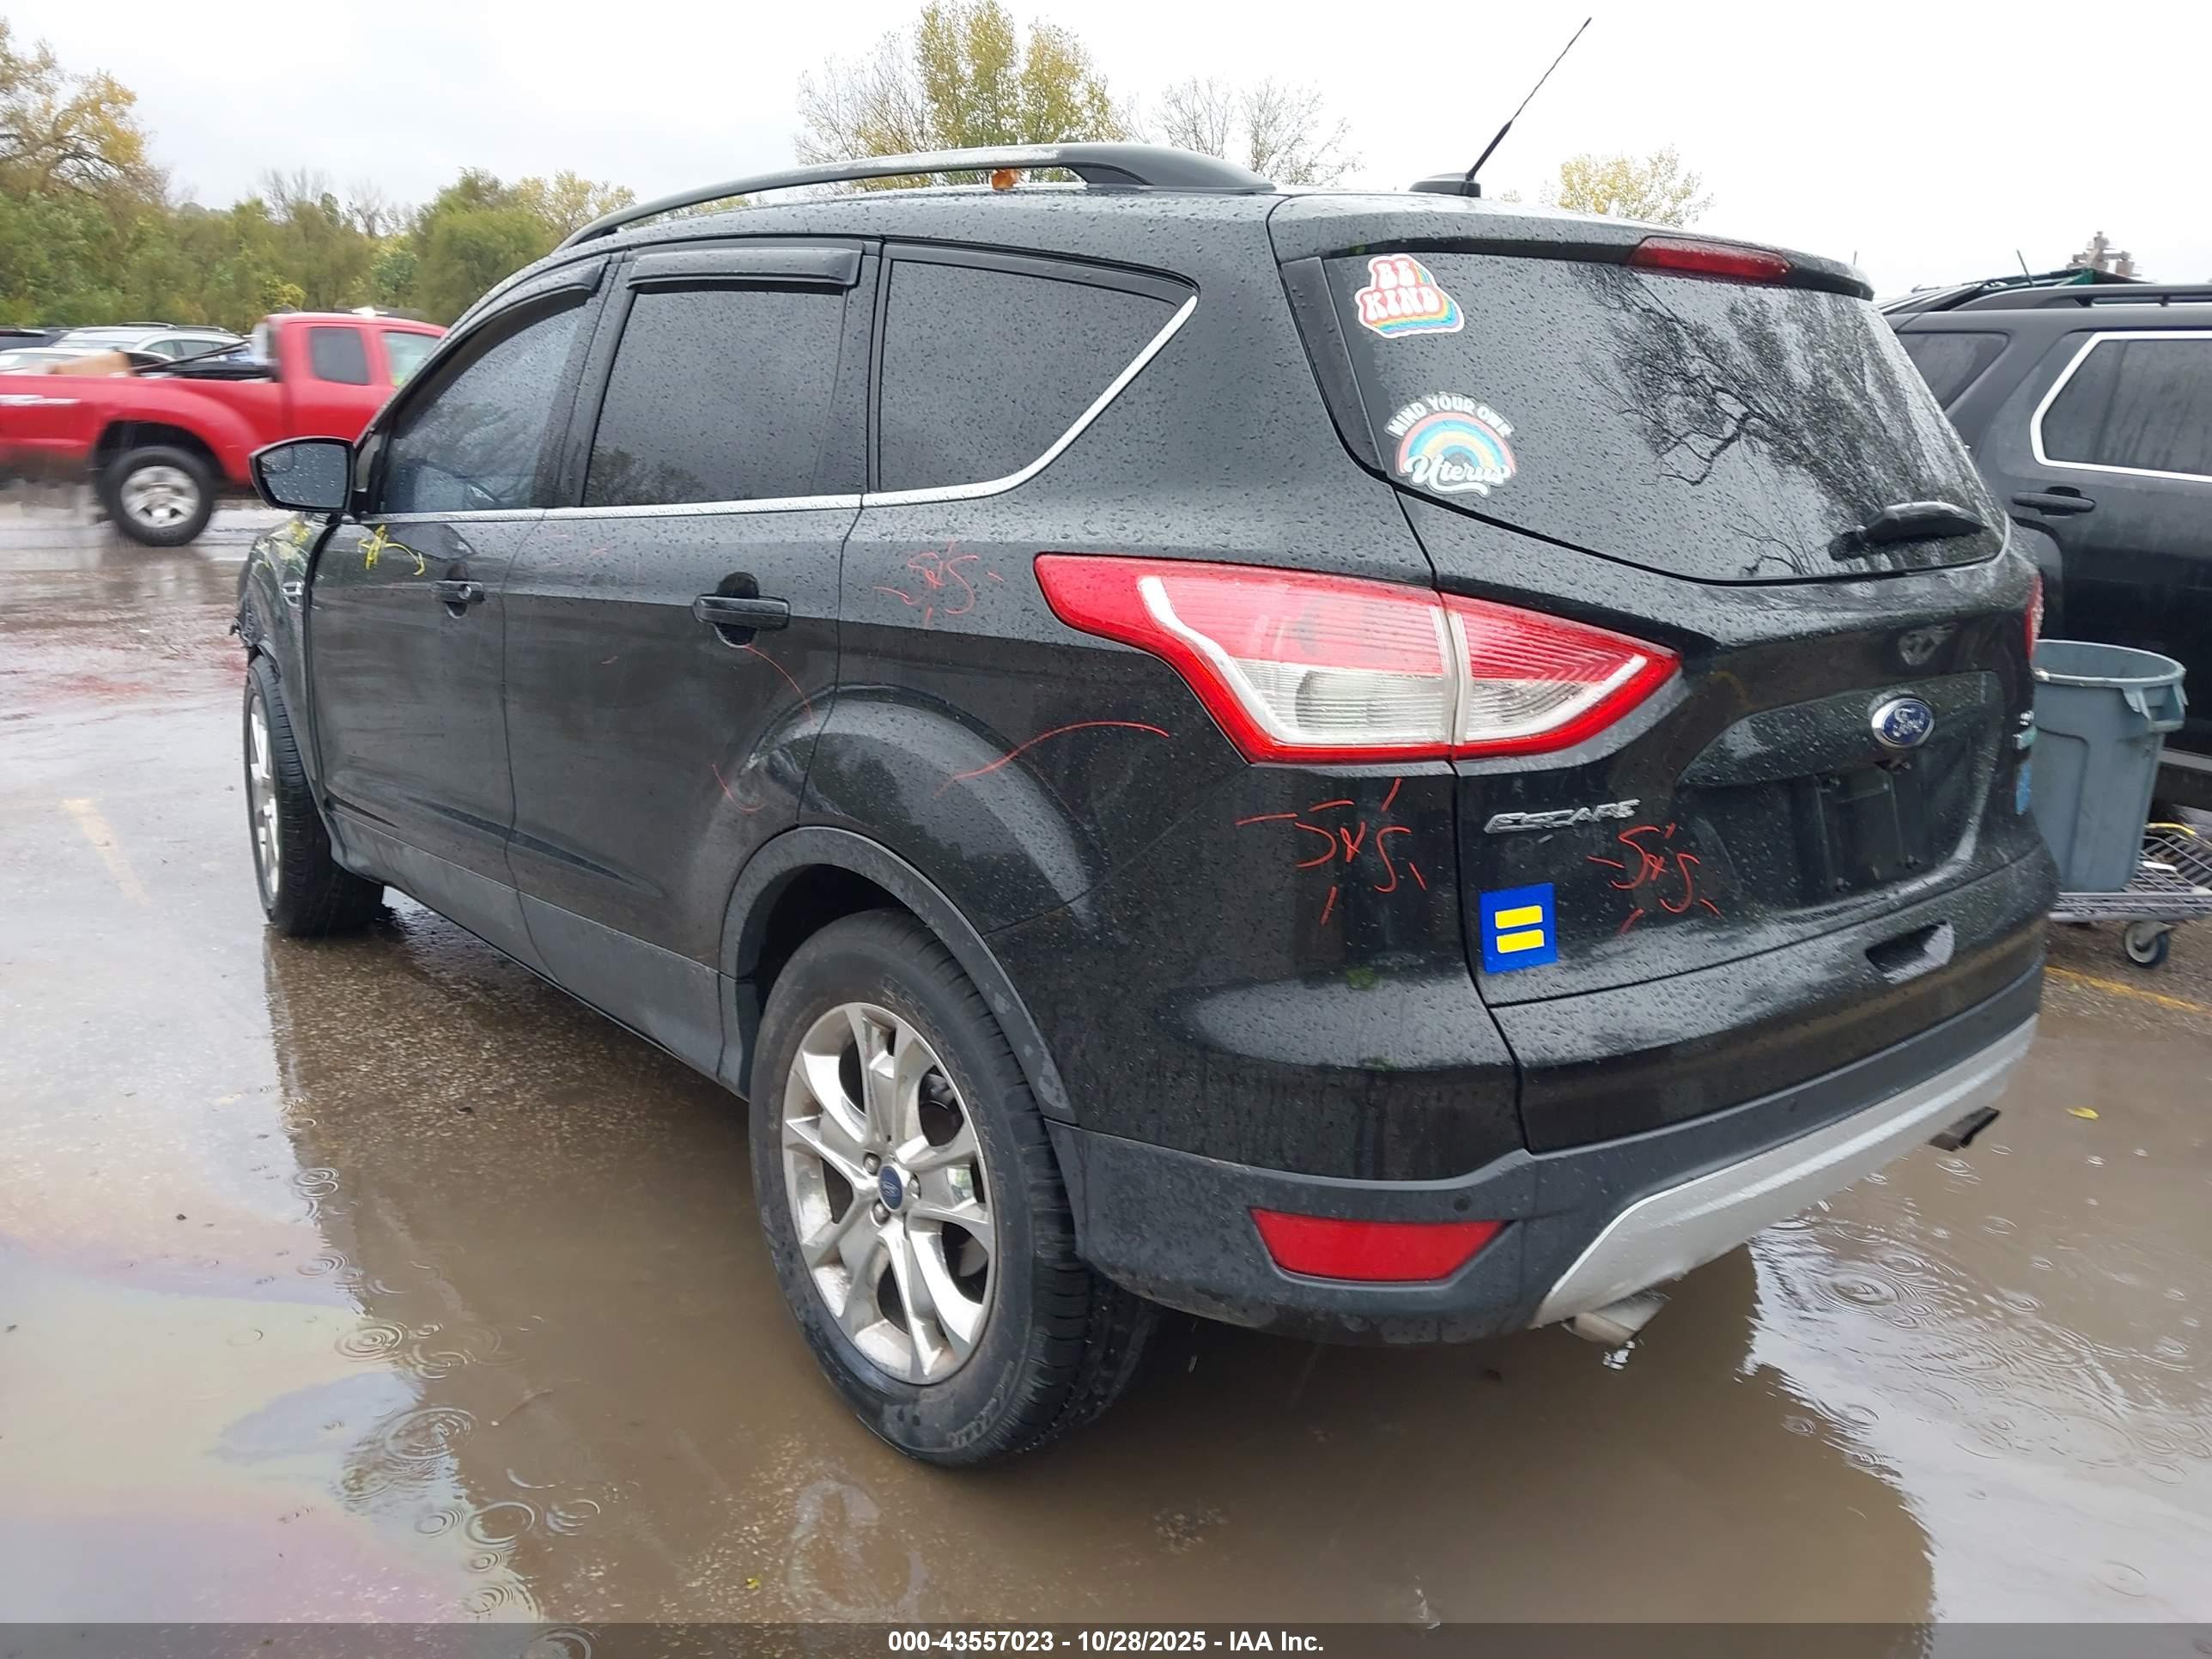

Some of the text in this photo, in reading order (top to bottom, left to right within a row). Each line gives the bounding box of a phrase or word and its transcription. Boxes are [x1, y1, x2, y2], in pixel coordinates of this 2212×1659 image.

[1375, 261, 1417, 289] BE
[1362, 286, 1440, 321] KIND
[1387, 402, 1427, 437] MIND
[1426, 394, 1475, 415] YOUR
[1403, 453, 1511, 495] Uterus
[1484, 799, 1642, 835] ESCAPE
